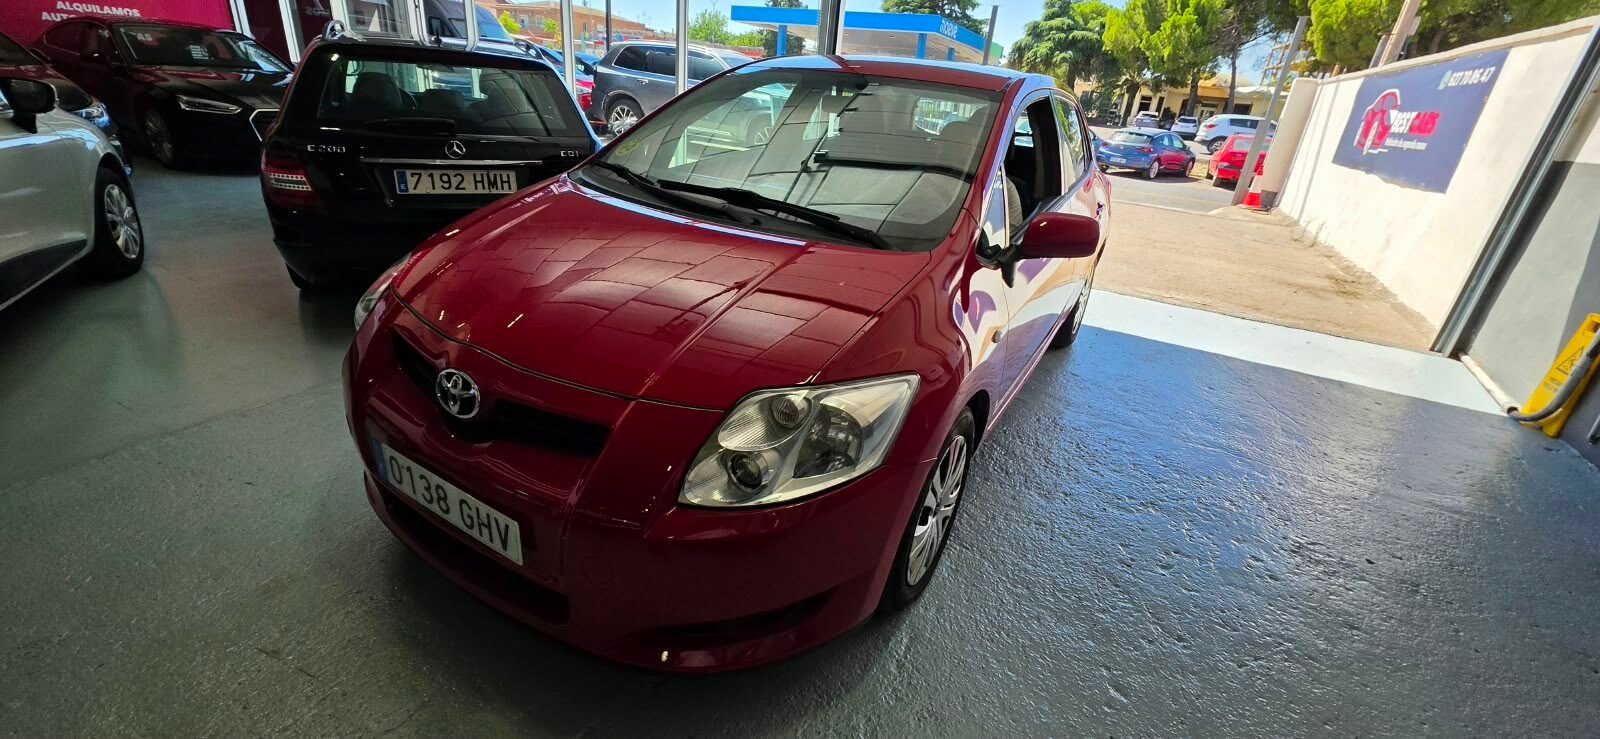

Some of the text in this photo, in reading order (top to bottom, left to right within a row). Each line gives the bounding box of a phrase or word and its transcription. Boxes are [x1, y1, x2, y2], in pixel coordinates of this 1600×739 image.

[56, 1, 141, 17] ALQUILAMOS
[410, 172, 466, 191] 7192
[473, 172, 512, 191] HMH
[388, 455, 510, 552] 0138 GHV
